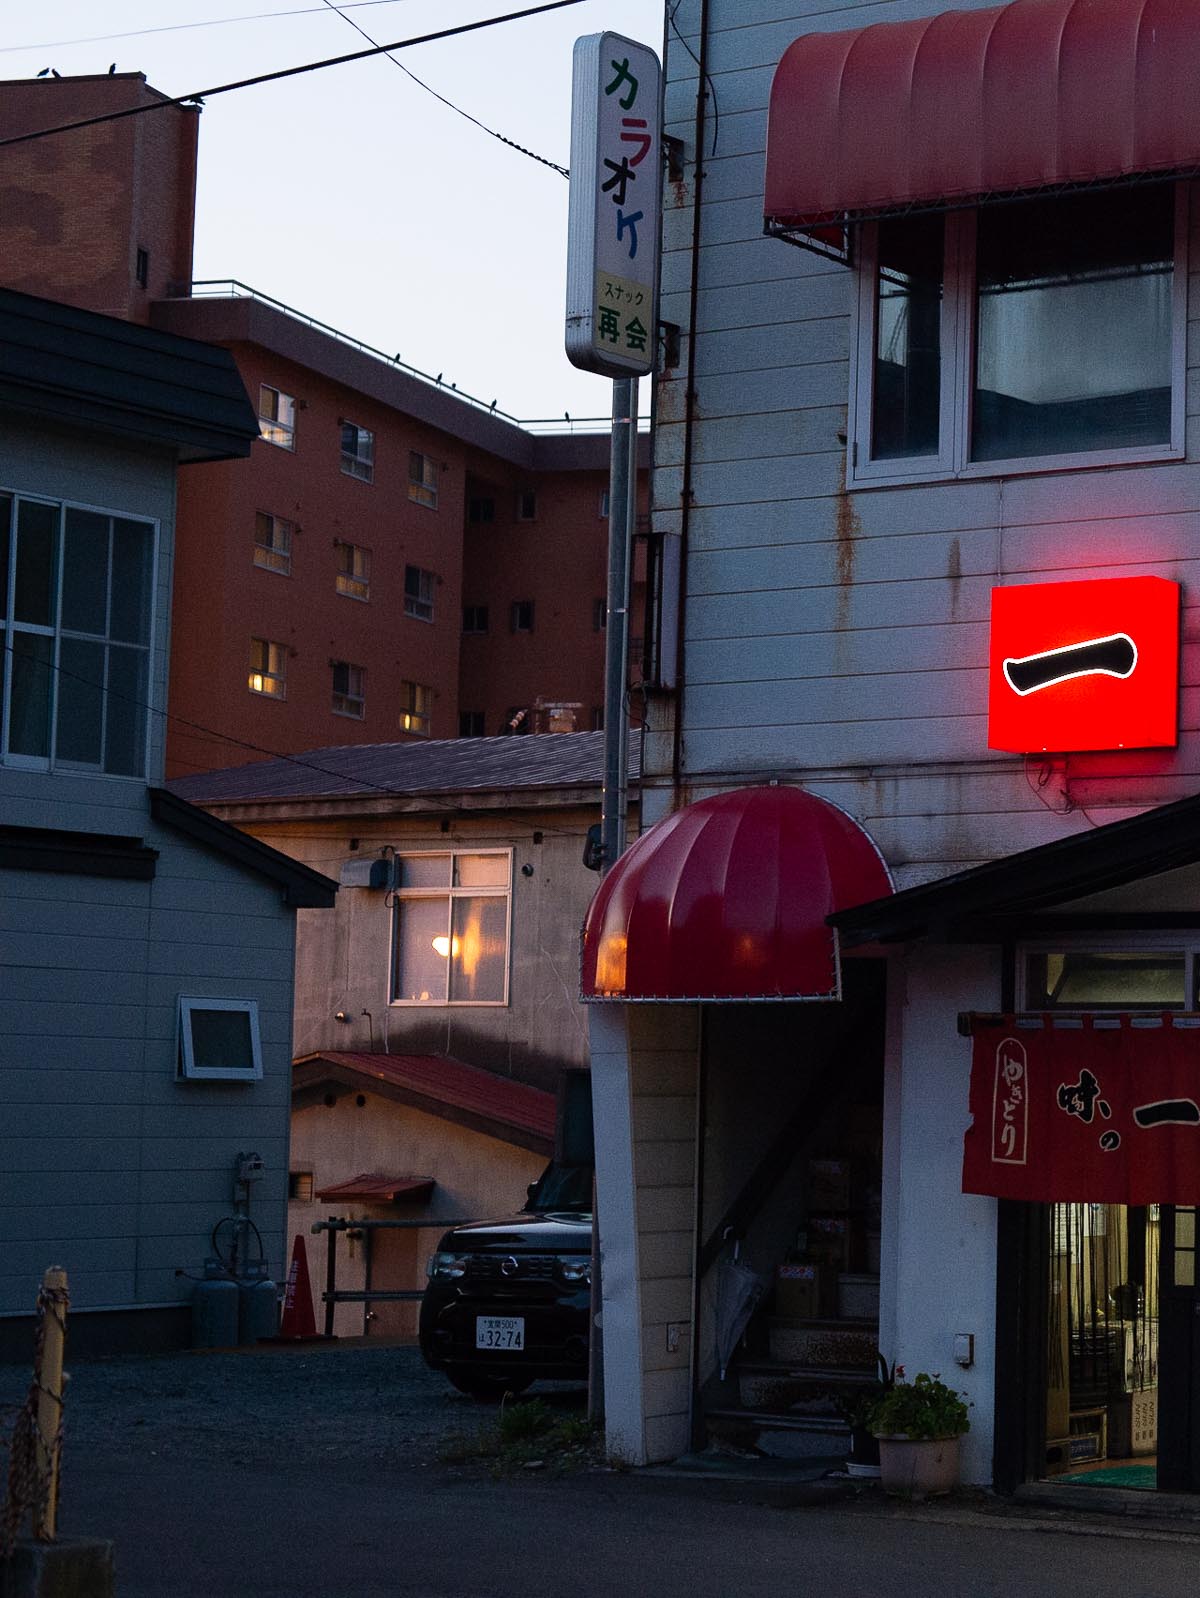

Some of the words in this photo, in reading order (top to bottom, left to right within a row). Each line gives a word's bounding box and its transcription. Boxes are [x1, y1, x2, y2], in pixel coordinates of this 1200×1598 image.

[604, 57, 652, 260] カラオケ
[598, 305, 648, 352] 再会
[605, 282, 644, 306] スナック
[1001, 1054, 1024, 1157] やきとり
